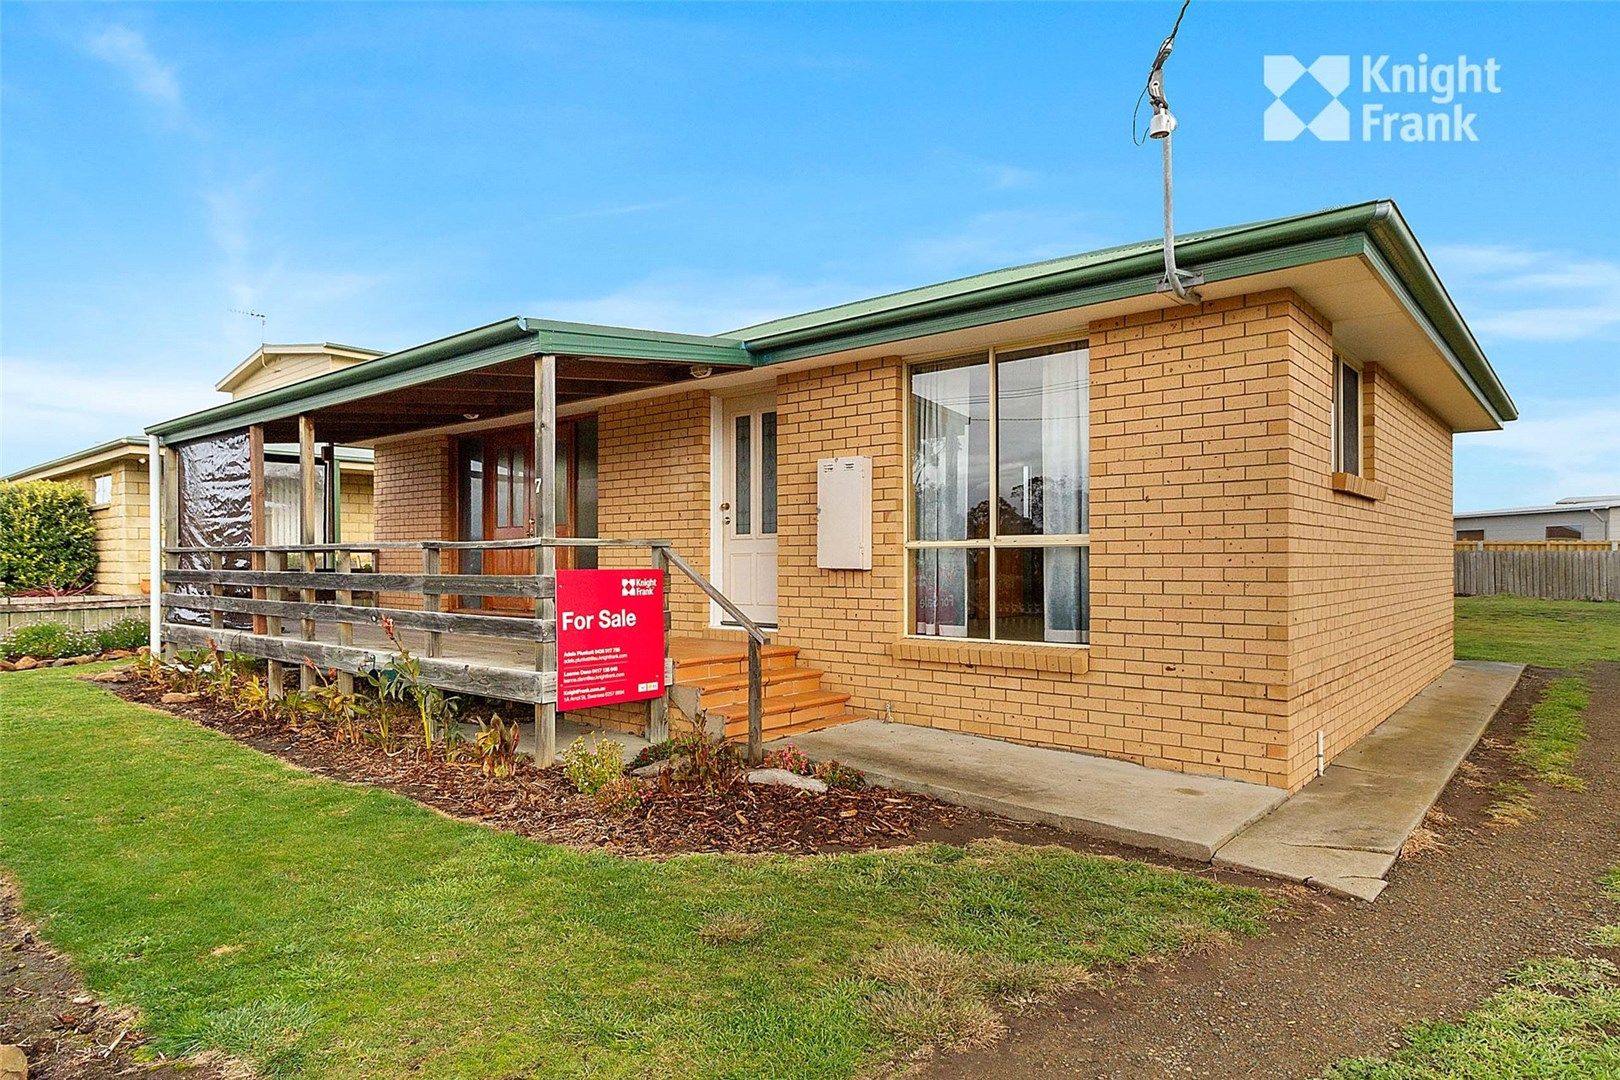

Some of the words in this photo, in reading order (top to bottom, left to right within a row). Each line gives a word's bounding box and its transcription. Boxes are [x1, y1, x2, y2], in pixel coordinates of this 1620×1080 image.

[535, 478, 542, 494] 7
[635, 578, 657, 588] Knight
[635, 587, 654, 596] Frank
[562, 611, 594, 631] For
[598, 609, 637, 629] Sale
